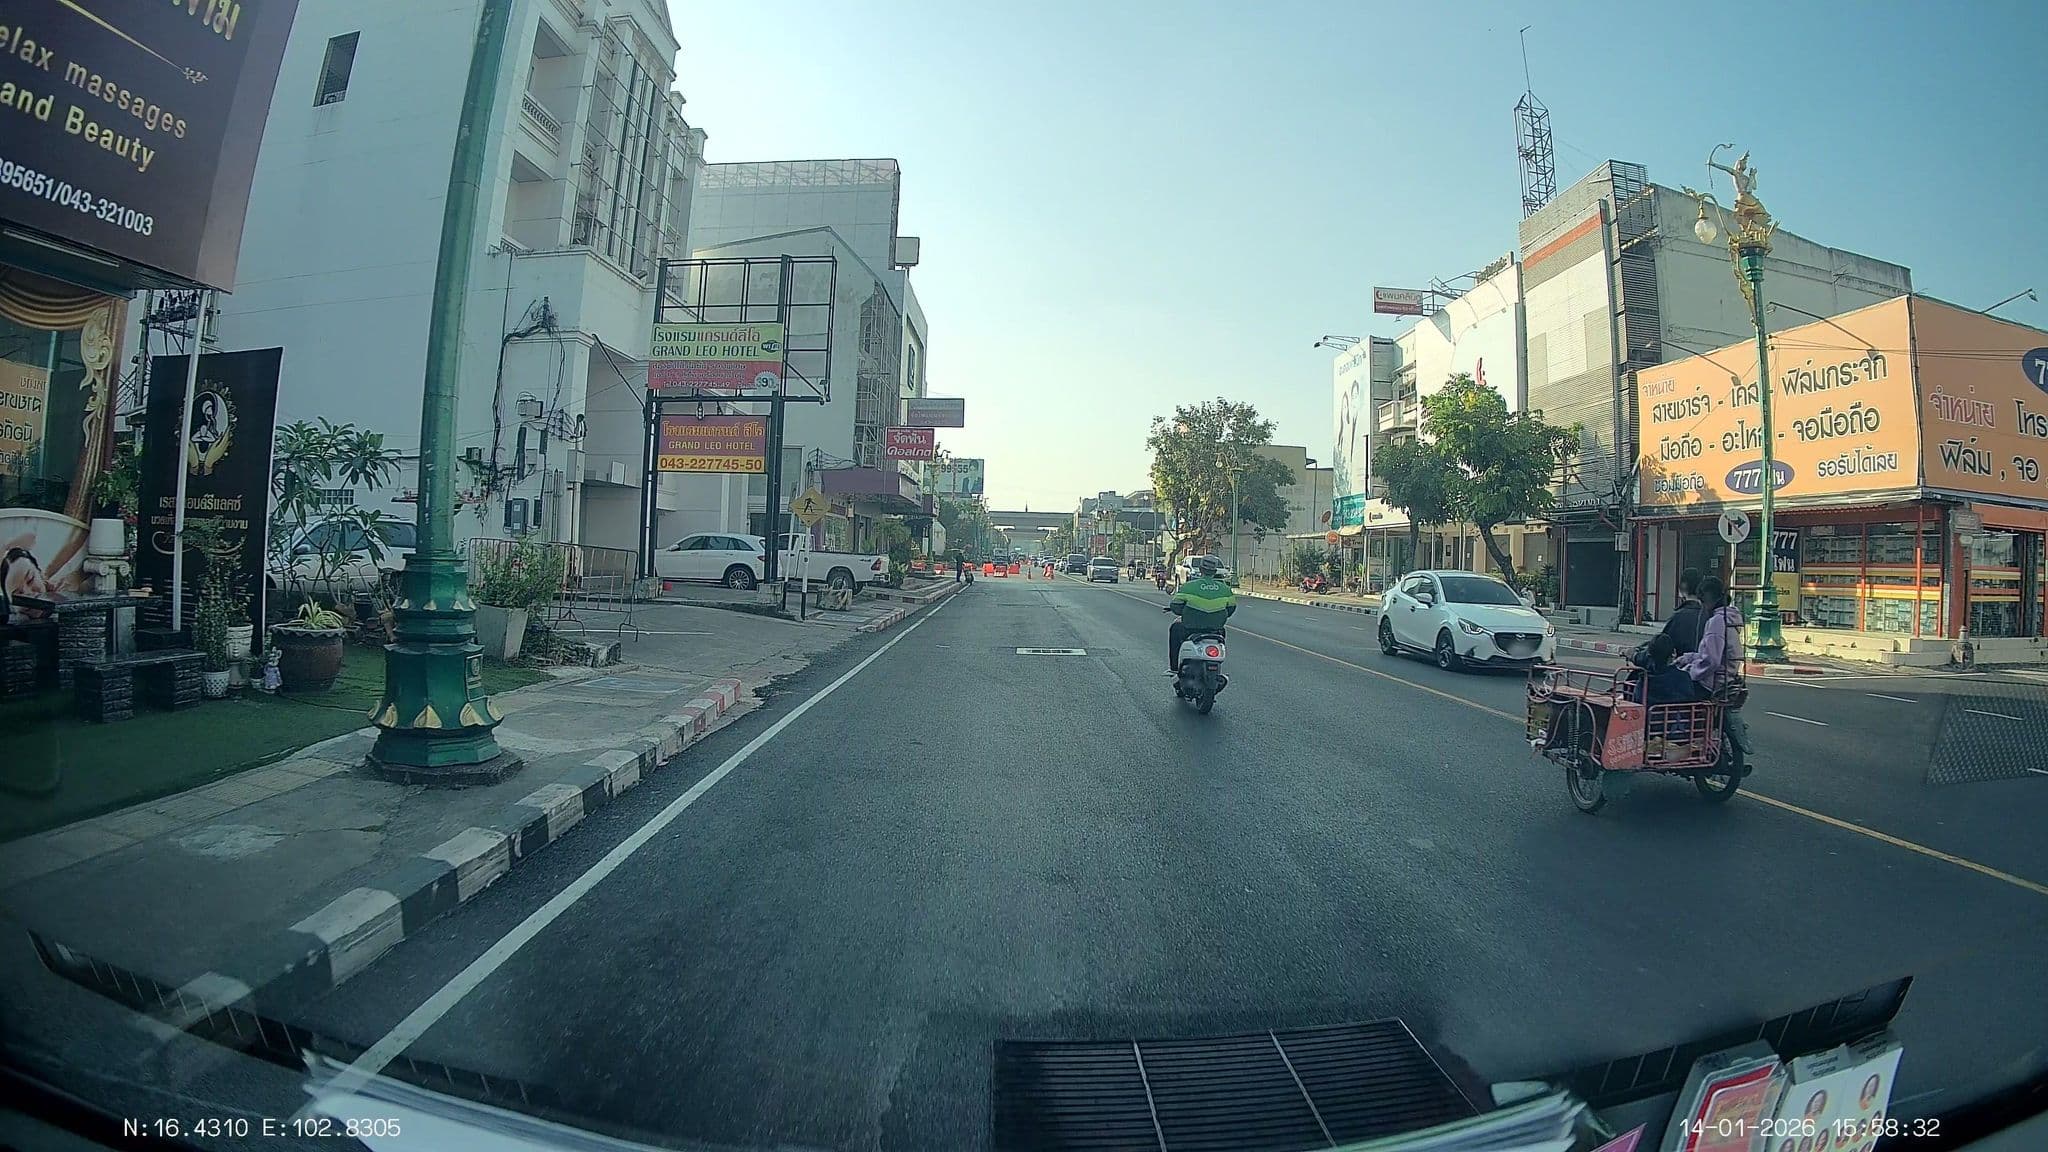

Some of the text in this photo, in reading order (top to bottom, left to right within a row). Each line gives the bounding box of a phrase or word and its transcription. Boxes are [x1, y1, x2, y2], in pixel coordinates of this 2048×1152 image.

[64, 61, 187, 139] massages
[0, 81, 156, 173] and Beauty
[0, 157, 154, 236] 95651/043-321003
[652, 345, 760, 357] GRAND LEO HOTEL
[1652, 386, 1712, 423] สายชาร์จ
[1781, 354, 1888, 396] ฟิล์มกระจก
[1929, 385, 1996, 428] จำหน่าย
[668, 441, 754, 450] GRAND LEO HOTEL
[1660, 432, 1703, 460] มือถือ
[1792, 401, 1881, 442] จอมือถือ
[660, 457, 762, 470] 043-227745-50
[1817, 445, 1899, 478] รอรับได้เลย
[1939, 437, 1993, 476] ฟิล์ม
[2012, 455, 2040, 483] จอ
[1772, 531, 1798, 549] 777
[1773, 555, 1795, 572] โฟน
